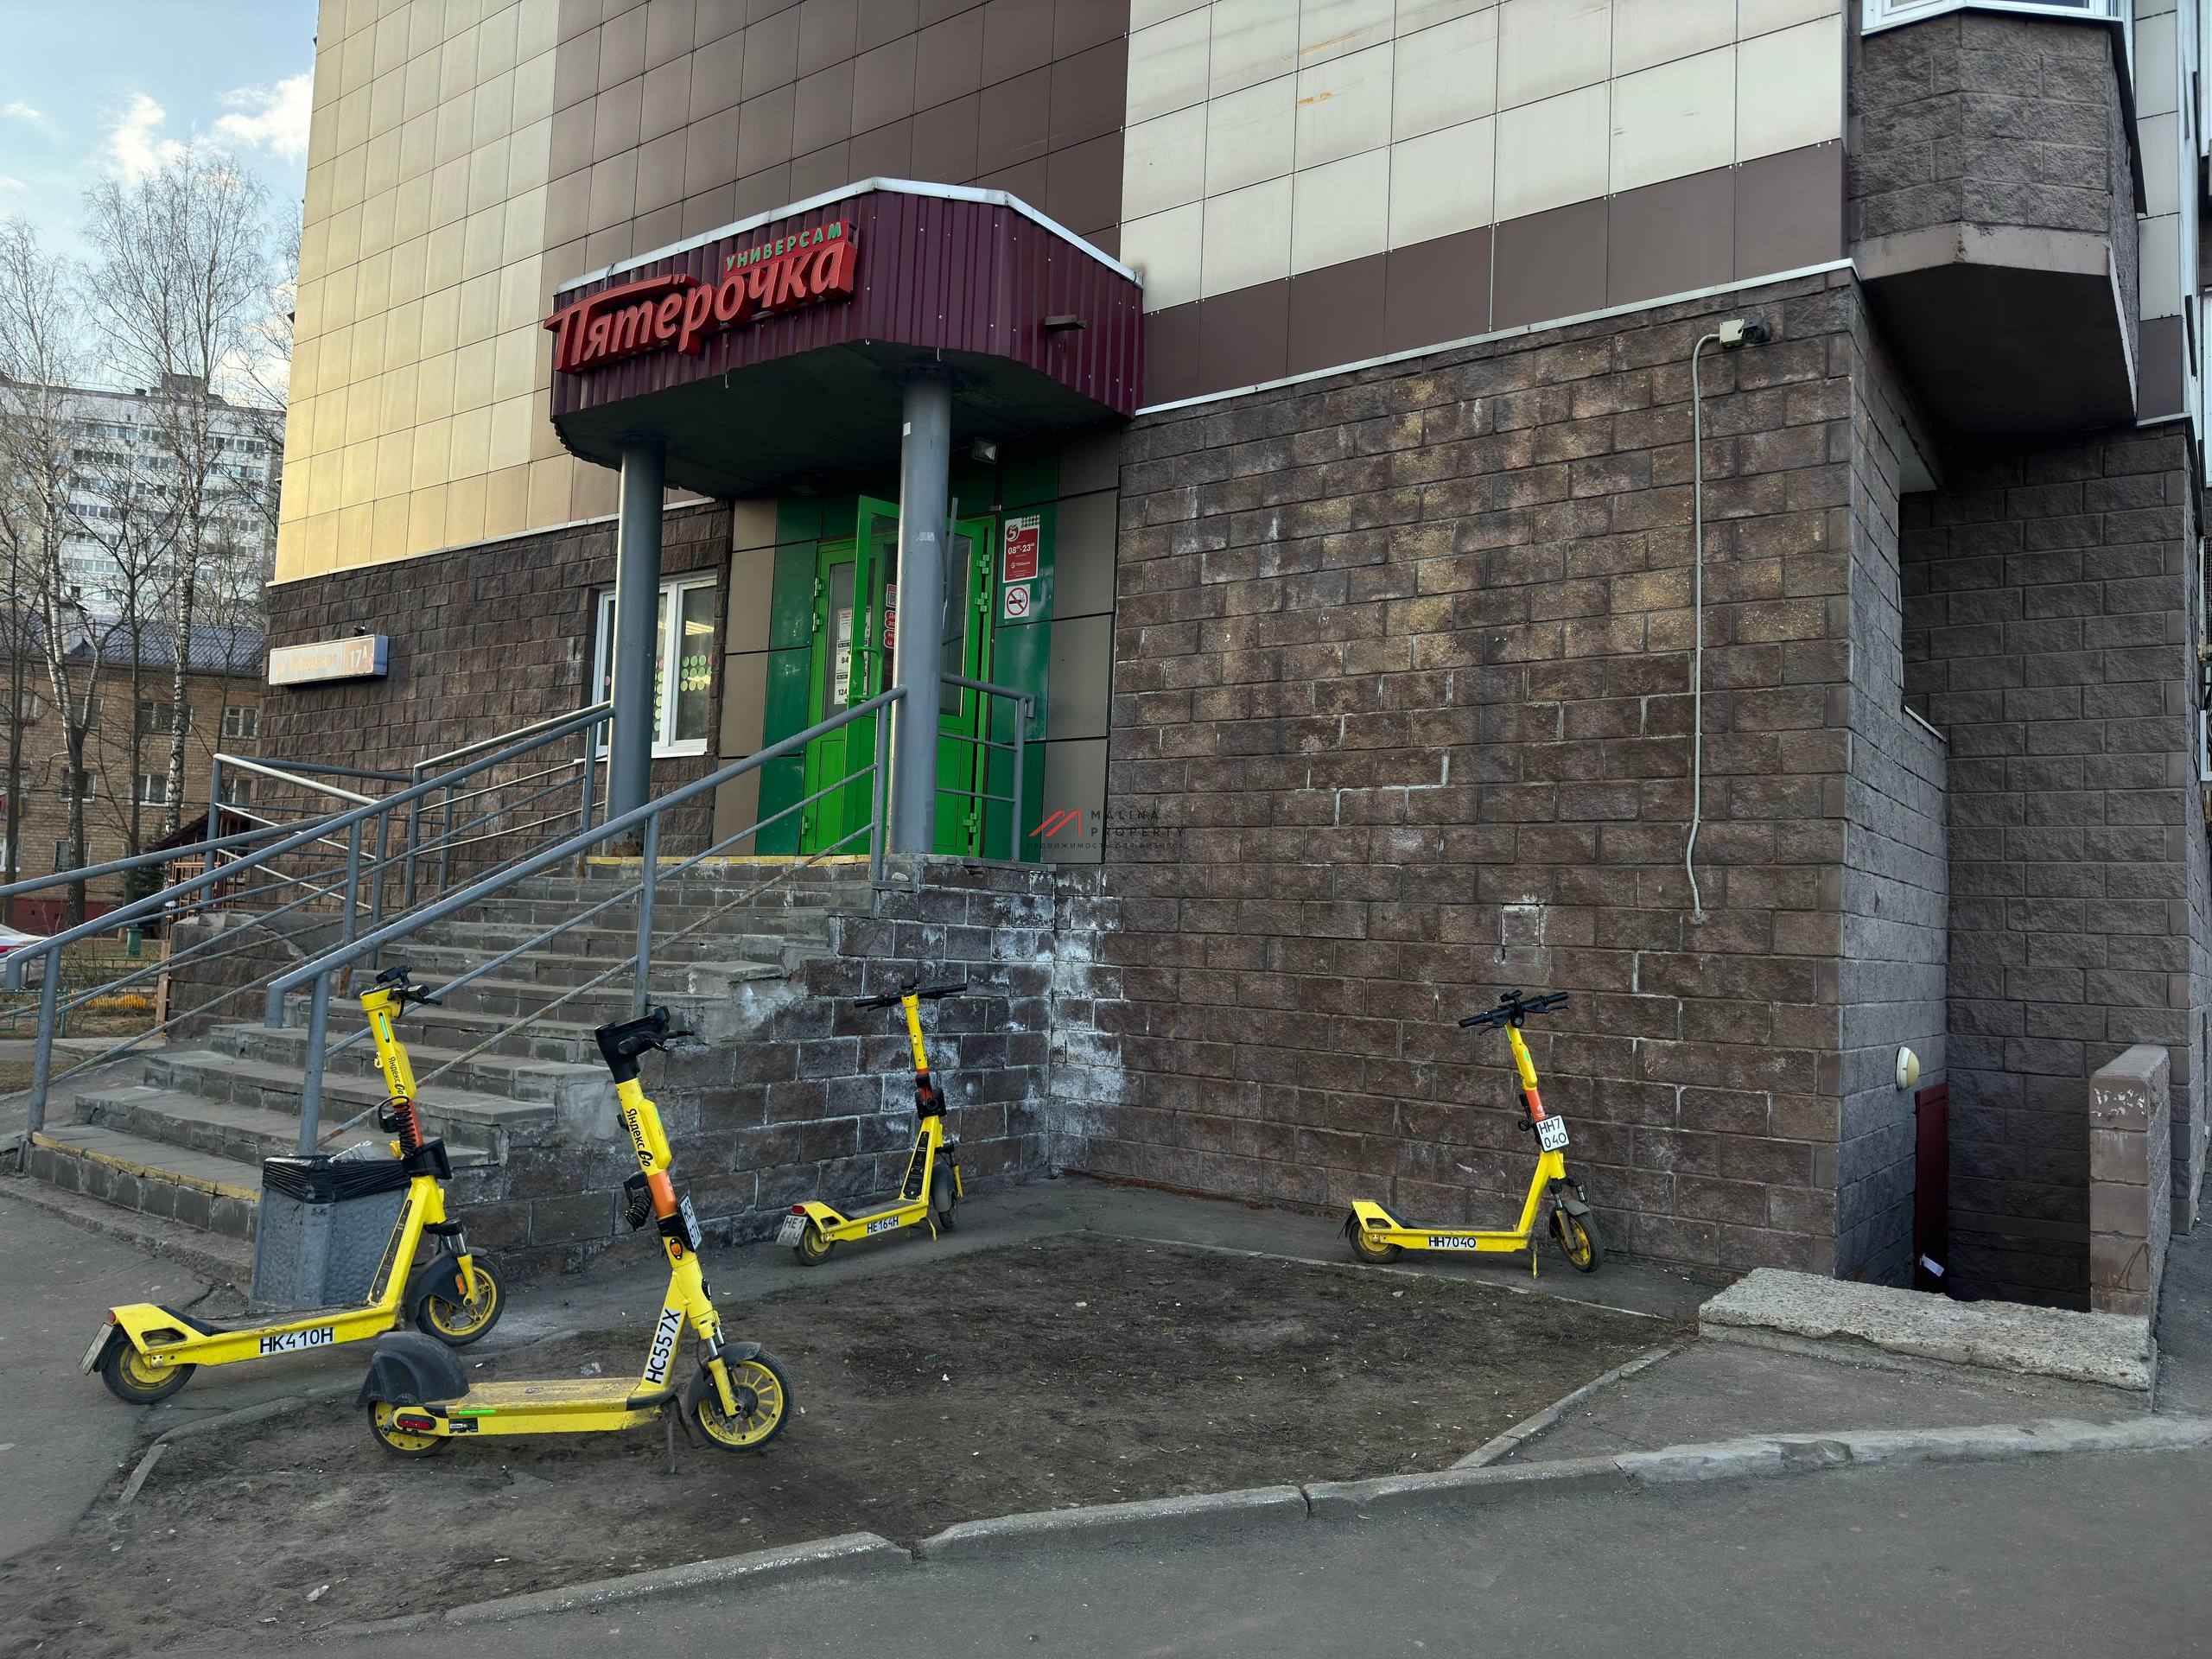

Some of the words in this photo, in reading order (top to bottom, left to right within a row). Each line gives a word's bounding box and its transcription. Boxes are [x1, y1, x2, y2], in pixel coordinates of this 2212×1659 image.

[726, 220, 842, 271] УНИВЕРСАМ
[543, 242, 850, 372] Пятёрочка
[388, 1056, 401, 1084] Яндекс
[394, 1084, 405, 1095] Go
[626, 1108, 645, 1149] Яндекс
[638, 1150, 654, 1167] Go
